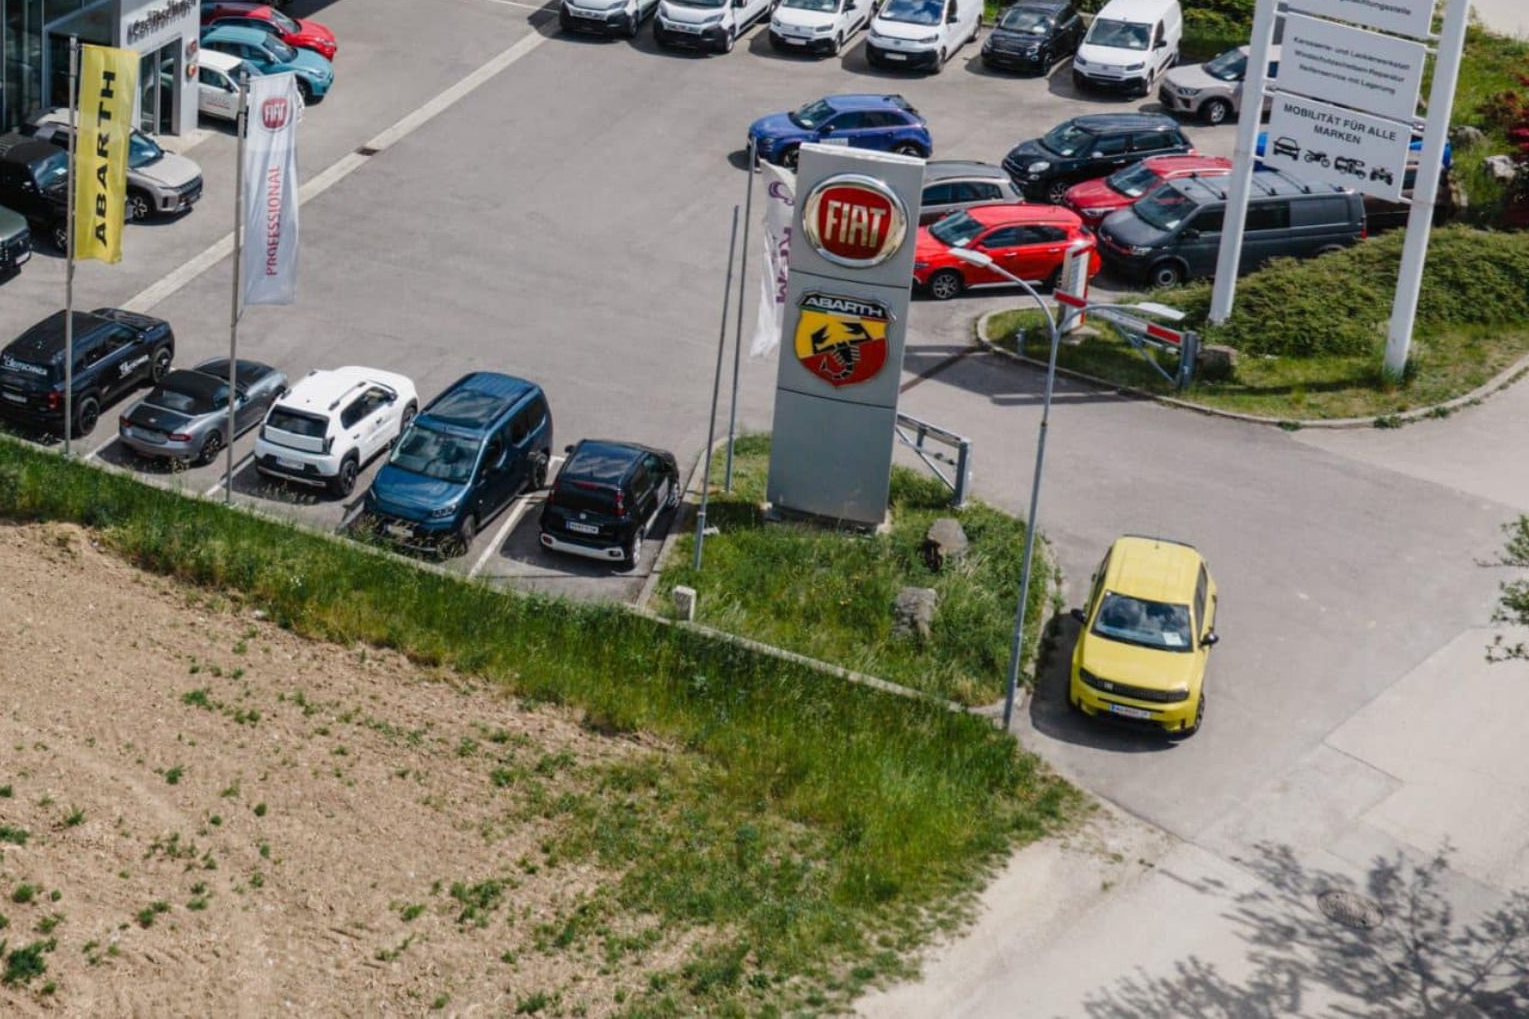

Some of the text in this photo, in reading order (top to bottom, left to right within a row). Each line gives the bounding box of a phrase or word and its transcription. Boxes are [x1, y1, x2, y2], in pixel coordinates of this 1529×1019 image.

[262, 103, 287, 125] FIAT
[1283, 103, 1397, 141] MOBILITÄT FÜR ALLE
[1313, 124, 1361, 145] MARKEN
[94, 70, 116, 247] ABARTH
[266, 166, 281, 277] PROFESSIONAL
[823, 200, 887, 249] FIAT
[805, 297, 883, 317] ABARTH
